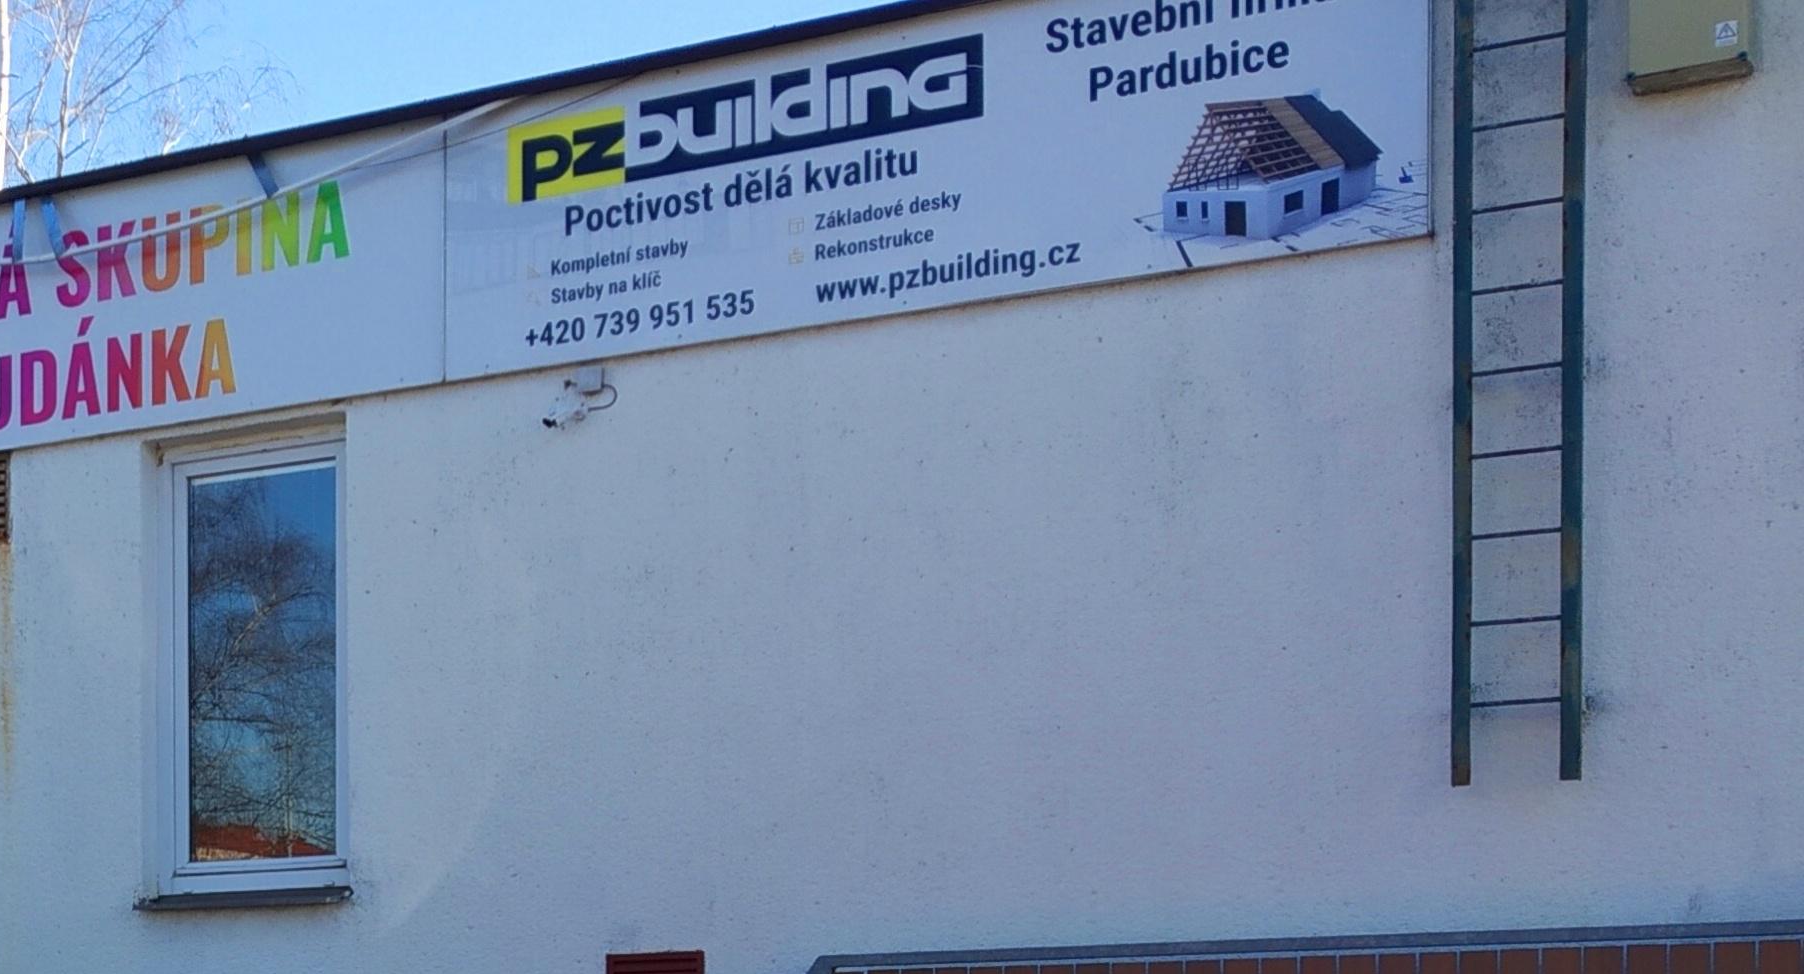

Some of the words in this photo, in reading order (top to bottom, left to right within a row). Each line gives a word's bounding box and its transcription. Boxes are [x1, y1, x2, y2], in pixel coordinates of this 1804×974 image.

[1089, 40, 1289, 102] Pardubice
[521, 52, 969, 202] pzbuilding
[564, 184, 713, 236] Poctivost
[724, 164, 793, 208] dělá
[804, 146, 919, 195] kvalitu
[814, 202, 904, 232] Základové
[908, 190, 961, 217] desky
[56, 181, 350, 308] SKUPINA
[550, 247, 632, 276] Kompletní
[636, 238, 689, 263] stavby
[814, 227, 934, 261] Rekonstrukce
[816, 242, 1081, 302] www.pzbuilding.cz
[550, 280, 604, 305] Stavby
[607, 281, 627, 296] na
[629, 271, 662, 292] klíč
[525, 319, 585, 349] +420
[595, 308, 639, 337] 739
[650, 299, 694, 328] 951
[706, 290, 755, 321] 535
